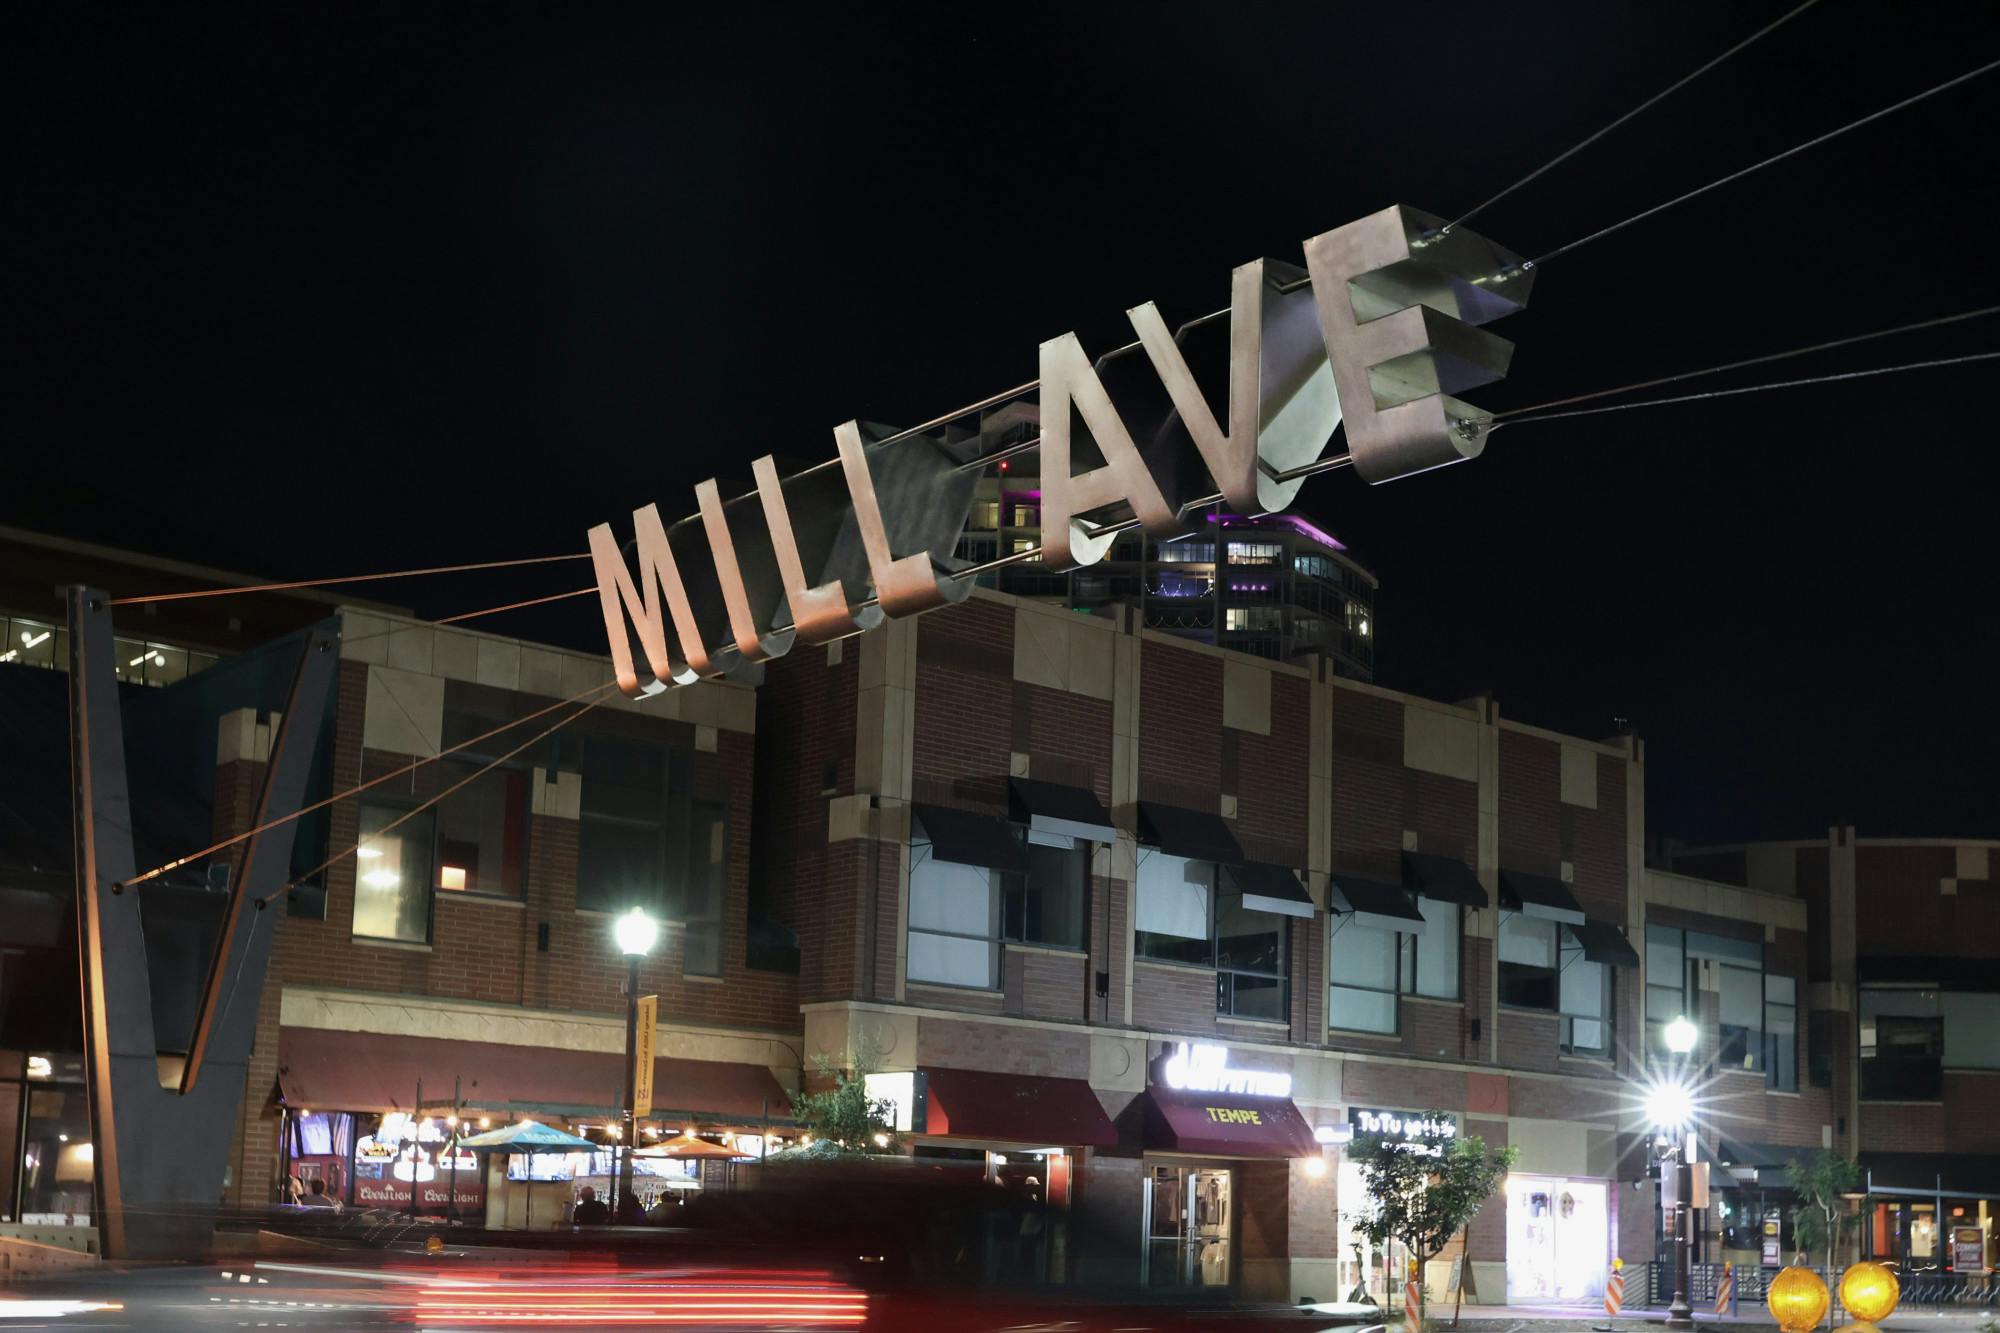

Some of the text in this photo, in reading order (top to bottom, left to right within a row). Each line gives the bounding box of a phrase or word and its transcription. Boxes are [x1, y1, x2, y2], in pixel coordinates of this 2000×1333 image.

[587, 204, 1482, 698] MILL AVE
[1206, 1107, 1262, 1126] TEMPE
